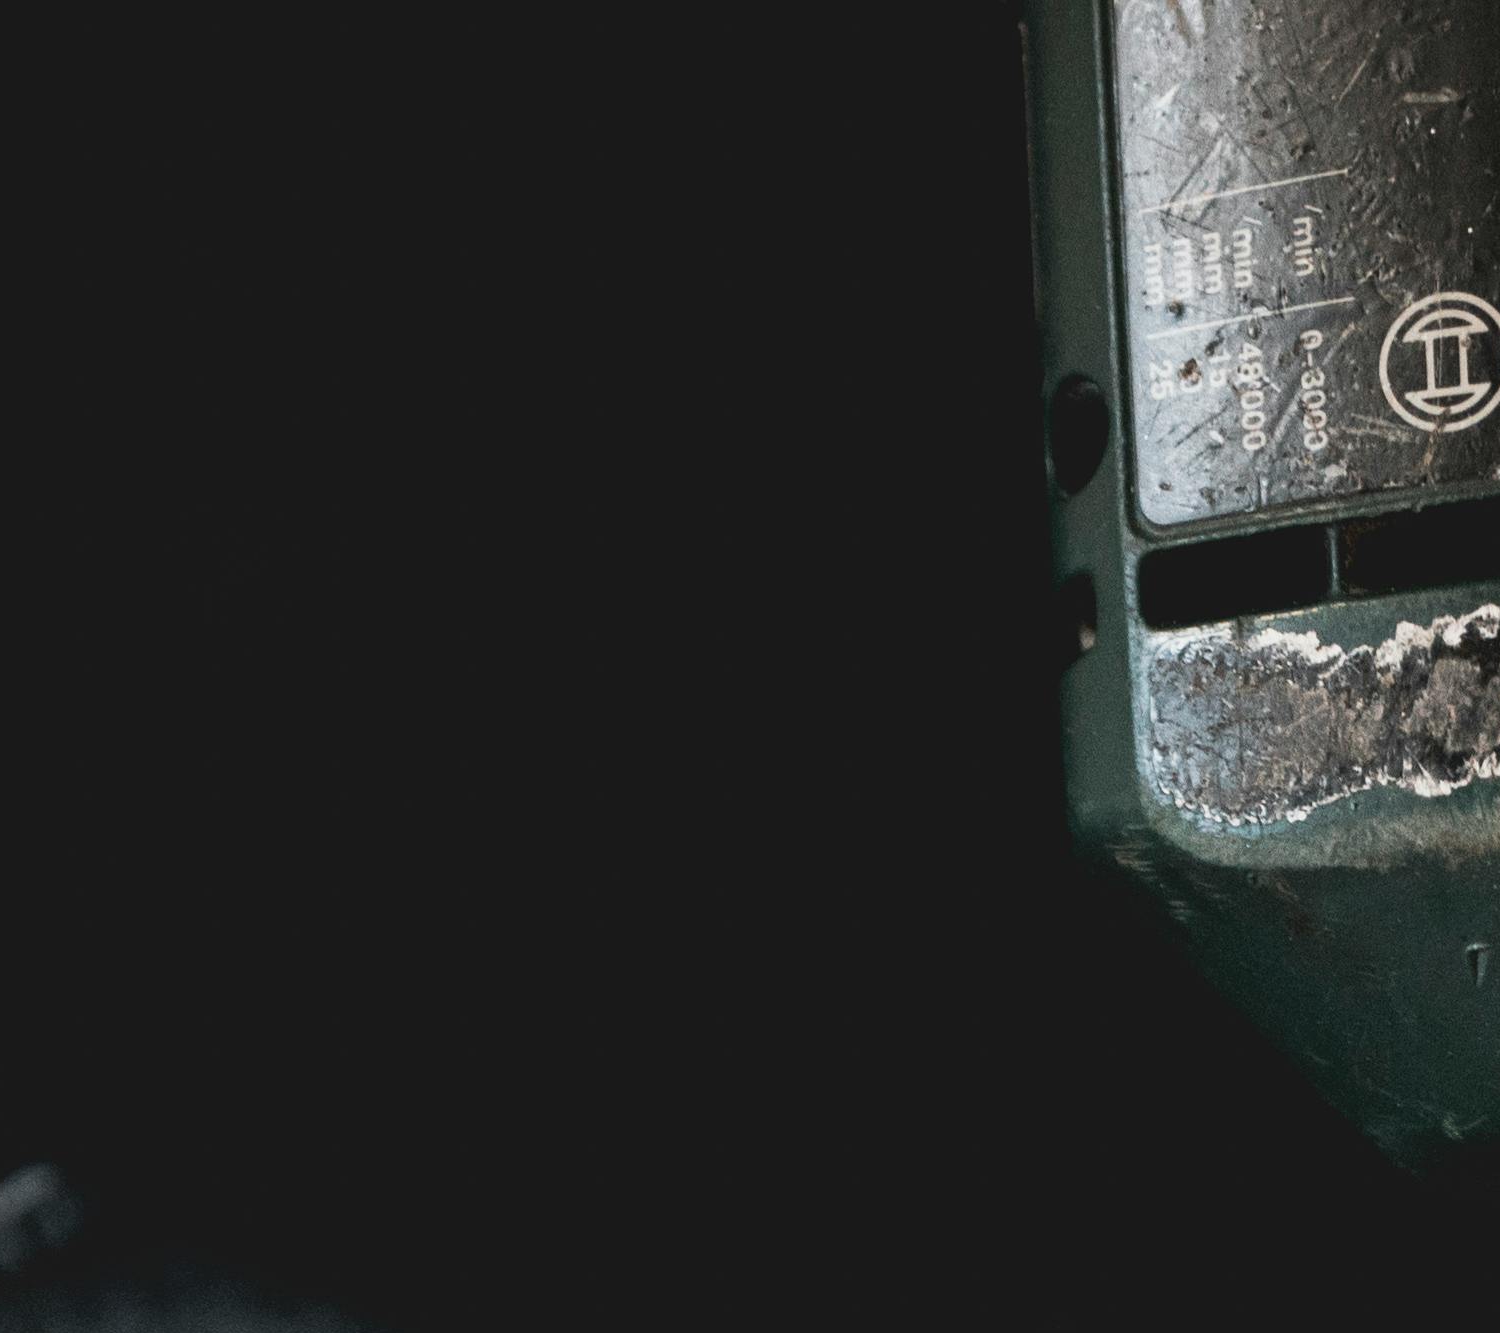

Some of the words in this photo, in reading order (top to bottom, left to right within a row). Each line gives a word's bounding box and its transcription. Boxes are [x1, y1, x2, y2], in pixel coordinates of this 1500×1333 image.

[1143, 242, 1164, 305] mm
[1172, 237, 1193, 300] mm
[1202, 231, 1223, 294] mm
[1148, 358, 1174, 401] 25
[1208, 350, 1232, 388] 15
